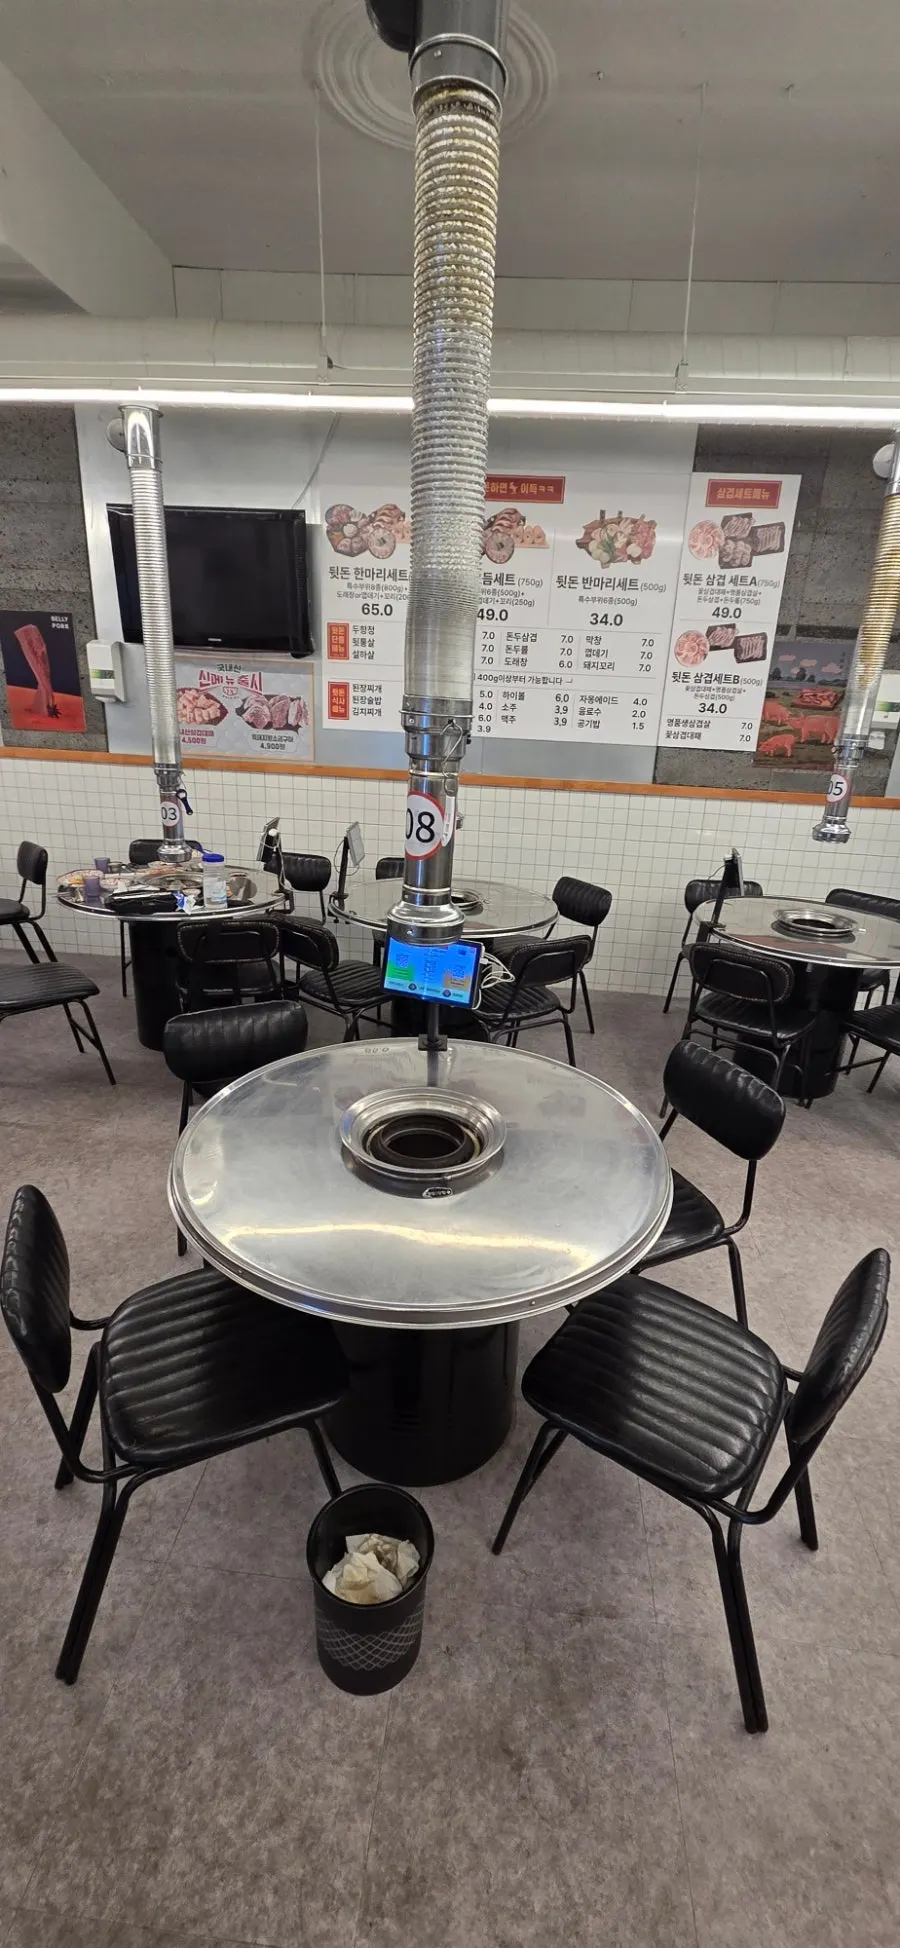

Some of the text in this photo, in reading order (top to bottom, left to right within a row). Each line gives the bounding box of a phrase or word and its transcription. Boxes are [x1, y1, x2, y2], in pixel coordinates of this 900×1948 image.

[717, 488, 770, 500] 삼겹세트메뉴
[328, 566, 409, 582] 뒷돈 한마리세트
[480, 572, 543, 588] 듬세트 (750g)
[556, 575, 667, 593] 뒷돈 반마리세트 (500g)
[683, 573, 780, 589] 뒷돈 삼겹 세트A (750g)
[361, 603, 393, 616] 65.0
[477, 608, 508, 621] 49.0
[712, 607, 742, 619] 49.0
[590, 613, 623, 626] 34.0
[352, 625, 375, 635] 두항정
[482, 631, 495, 640] 7.0
[506, 632, 574, 643] 돈두삼겹 7.0
[585, 635, 654, 647] 막창 7.0
[481, 644, 494, 652] 7.0
[560, 648, 572, 656] 7.0
[584, 648, 653, 660] 껍데기 7.0
[481, 656, 494, 665] 7.0
[559, 660, 572, 668] 6.0
[216, 664, 242, 673] 국내산
[583, 661, 651, 672] 돼지꼬리 7.0
[477, 674, 563, 685] 400g이상부터 가능합니다
[672, 671, 763, 687] 뒷돈 삼겹세트B (500g)
[352, 684, 382, 693] 된장찌개
[479, 690, 493, 698] 5.0
[502, 691, 569, 703] 하이볼 6.0
[579, 695, 648, 706] 자몽에이드 4.0
[478, 702, 493, 710] 4.0
[501, 703, 517, 712] 소주
[698, 702, 727, 714] 34.0
[352, 707, 382, 717] 김치찌개
[578, 706, 646, 718] 음료수 2.0
[478, 714, 492, 722] 6.0
[501, 715, 516, 724] 맥주
[477, 725, 491, 733] 3.9
[577, 719, 644, 730] 공기밥 1.5
[741, 722, 752, 730] 7.0
[828, 781, 844, 796] 05
[161, 807, 177, 820] 03
[406, 808, 435, 843] 08
